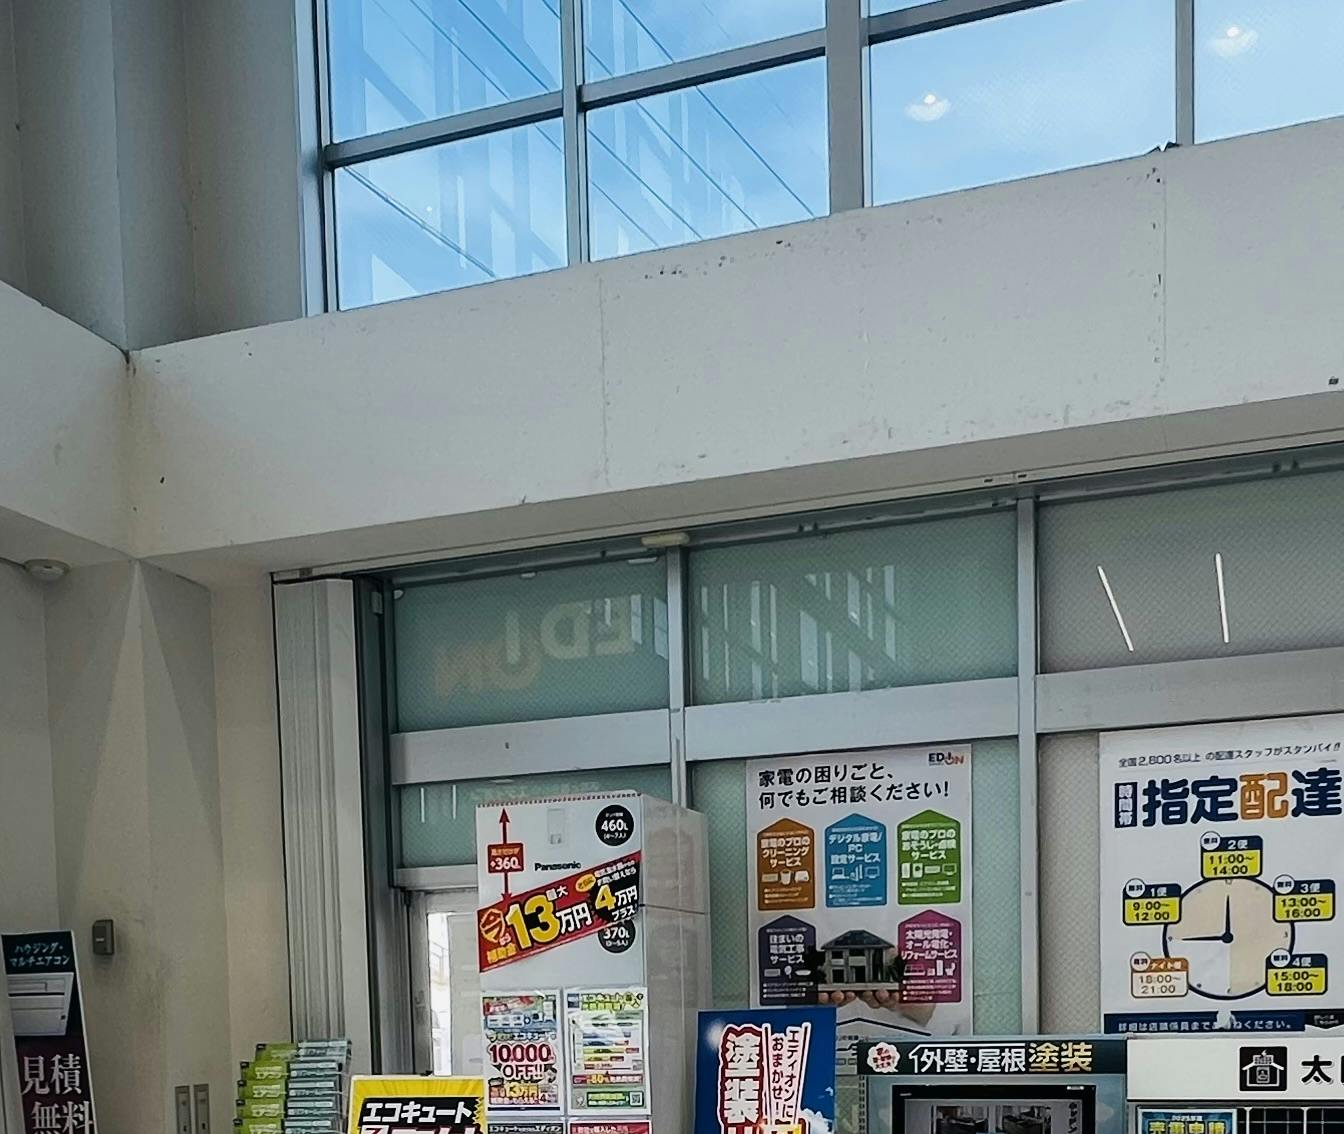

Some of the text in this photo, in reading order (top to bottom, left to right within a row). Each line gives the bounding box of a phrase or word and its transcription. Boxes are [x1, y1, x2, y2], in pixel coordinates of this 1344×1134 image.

[928, 752, 965, 766] EDION
[758, 763, 895, 788] 家電の困りごと、
[758, 781, 949, 809] 何でもご相談ください!
[1142, 767, 1343, 827] 指定配達
[762, 848, 809, 858] クリーニング
[848, 844, 863, 853] PC
[911, 851, 947, 860] サービス
[534, 861, 582, 871] Panasonic
[770, 858, 802, 868] サービス
[1212, 865, 1249, 876] 14:00
[1300, 883, 1321, 893] 3便
[595, 885, 638, 911] 4万円
[1134, 912, 1170, 921] 12:00
[1285, 908, 1321, 918] 16:00
[506, 894, 592, 950] 13万円
[769, 935, 804, 945] 住まいの
[9, 953, 71, 968] マルチエアコン
[770, 955, 805, 965] サービス
[1292, 956, 1312, 967] 4便
[1141, 985, 1176, 994] 21:00
[1276, 982, 1313, 992] 18:00
[920, 1043, 1093, 1073] 外壁・屋根塗装
[22, 1054, 82, 1096] 見積
[772, 1037, 784, 1115] おまかせ!
[782, 1030, 800, 1118] エディオンに
[363, 1101, 472, 1123] エコキュート
